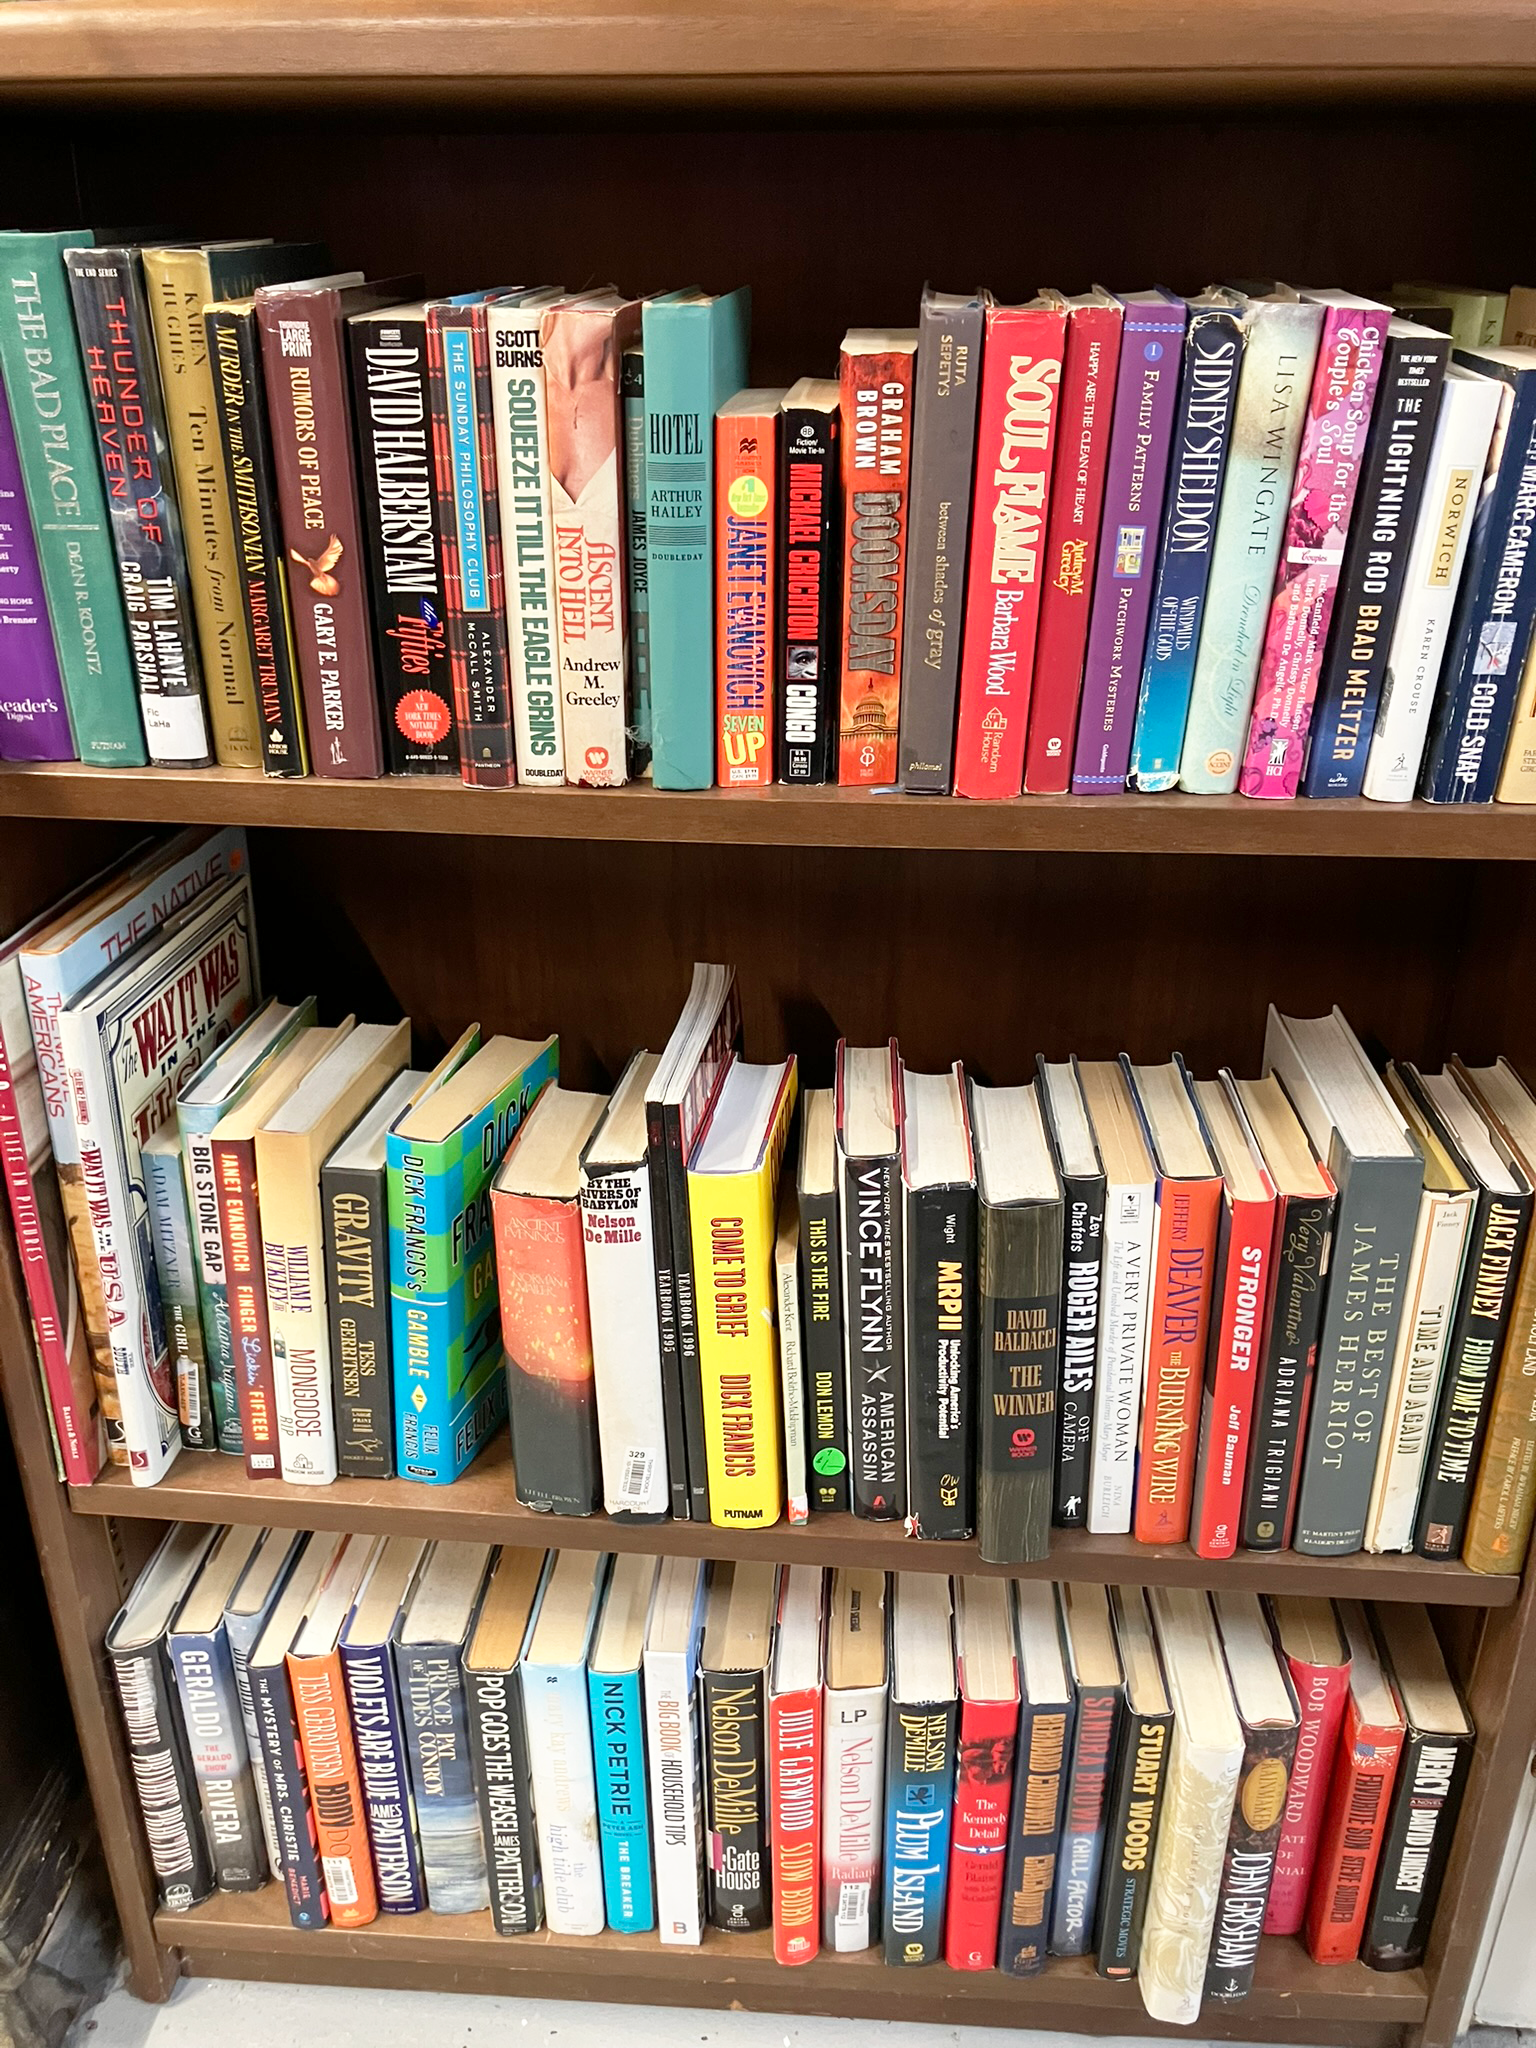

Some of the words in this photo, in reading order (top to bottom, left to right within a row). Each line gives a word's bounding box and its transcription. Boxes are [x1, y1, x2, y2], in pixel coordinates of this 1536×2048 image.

[12, 271, 48, 341] THE
[184, 293, 207, 366] KAREN
[280, 329, 311, 342] LARGE
[496, 330, 540, 347] SCOTT
[496, 350, 543, 368] BURNS
[24, 347, 63, 419] BAD
[366, 347, 424, 425] DAVID
[938, 335, 953, 397] SEPETYS
[955, 345, 968, 386] RUTA
[1270, 355, 1297, 414] LISA
[87, 346, 128, 497] HEAVEN
[106, 297, 152, 480] THUNDER
[138, 498, 163, 543] OF
[290, 367, 316, 442] RUMORS
[880, 382, 904, 475] GRAHAM
[650, 413, 703, 455] HOTEL
[855, 390, 878, 469] BROWN
[41, 424, 81, 516] PLACE
[298, 447, 319, 470] OF
[301, 474, 325, 530] PEACE
[373, 430, 438, 594] HALBERSTAM
[651, 490, 702, 502] ARTHUR
[651, 506, 702, 518] HAILEY
[789, 463, 823, 544] MICHAEL
[1247, 427, 1286, 555] WINGATE
[936, 501, 952, 550] between
[1435, 477, 1468, 580] NORWICH
[727, 516, 767, 585] JANET
[147, 576, 176, 610] TIM
[788, 550, 821, 640] CRICHTON
[849, 492, 901, 675] DOOMSDAY
[933, 555, 950, 604] shades
[928, 608, 945, 626] of
[1113, 588, 1133, 660] PATCHWORK
[1351, 605, 1383, 661] BRAD
[1420, 619, 1436, 660] KAREN
[153, 620, 187, 687] LAHAYE
[467, 623, 479, 675] McCALL
[563, 657, 621, 671] Andrew
[726, 592, 766, 709] EVANOVICH
[924, 629, 944, 670] gray
[472, 681, 483, 722] SMITH
[566, 692, 621, 708] Greeley
[785, 684, 817, 743] CONGO
[1104, 665, 1123, 732] MYSTERIES
[1408, 666, 1425, 714] CROUSE
[1465, 683, 1498, 731] COLD
[1332, 669, 1370, 760] MELTZER
[525, 768, 564, 777] DOUBLEDAY
[722, 732, 766, 766] UP
[990, 732, 1004, 773] Random
[1266, 766, 1283, 776] HCI
[1455, 735, 1486, 783] SNAP
[193, 1147, 211, 1174] BIG
[221, 1154, 241, 1193] JANET
[587, 1179, 603, 1189] BY
[605, 1178, 631, 1188] THE
[197, 1181, 218, 1234] STONE
[582, 1199, 638, 1209] BABYLON
[587, 1214, 636, 1228] Nelson
[858, 1168, 882, 1258] VINCE
[883, 1189, 891, 1216] YORK
[227, 1199, 250, 1272] EVANOVICH
[333, 1193, 374, 1308] GRAVITY
[711, 1217, 746, 1265] COME
[810, 1218, 828, 1248] THIS
[883, 1218, 891, 1247] TIMES
[204, 1241, 223, 1273] GAP
[714, 1268, 747, 1288] TO
[811, 1251, 828, 1264] IS
[812, 1267, 829, 1290] THE
[884, 1249, 892, 1310] BESTSELLING
[1343, 1223, 1376, 1322] JAMES
[659, 1269, 674, 1324] YEARBOOK
[678, 1272, 695, 1328] YEARBOOK
[783, 1272, 796, 1312] Alexander
[813, 1294, 830, 1321] FIRE
[1067, 1260, 1100, 1332] ROGER
[1371, 1253, 1400, 1316] THE
[715, 1292, 749, 1337] GRIEF
[785, 1312, 796, 1332] Kent
[860, 1268, 884, 1352] FLYNN
[885, 1313, 893, 1351] AUTHOR
[1007, 1308, 1047, 1330] DAVID
[1230, 1246, 1262, 1372] STRONGER
[339, 1318, 360, 1398] GERRITSEN
[359, 1341, 376, 1376] TESS
[407, 1309, 430, 1379] GAMBLE
[663, 1328, 676, 1353] 1995
[681, 1332, 695, 1357] 1996
[950, 1339, 961, 1385] Unlocking
[994, 1327, 1057, 1352] BALDACCI
[815, 1371, 832, 1396] DON
[937, 1339, 949, 1396] Productivity
[1009, 1365, 1042, 1388] THE
[1063, 1336, 1096, 1393] AILES
[1359, 1329, 1388, 1399] BEST
[290, 1349, 321, 1437] MONGOOSE
[720, 1374, 752, 1409] DICK
[950, 1386, 962, 1430] America's
[1271, 1357, 1298, 1428] ADRIANA
[1322, 1336, 1360, 1470] HERRIOT
[817, 1399, 834, 1439] LEMON
[862, 1394, 878, 1481] ASSASSIN
[879, 1391, 896, 1483] AMERICAN
[938, 1397, 950, 1439] Potential
[1352, 1411, 1374, 1443] OF
[629, 1450, 646, 1459] 329
[722, 1413, 756, 1477] FRANCIS
[1260, 1439, 1287, 1509] TRIGIANI
[412, 1659, 427, 1672] OF
[448, 1666, 460, 1690] THE
[409, 1677, 433, 1727] TIDES
[427, 1659, 454, 1727] PRINCE
[476, 1675, 507, 1711] POP
[602, 1683, 627, 1735] NICK
[841, 1709, 867, 1724] LP
[1308, 1677, 1329, 1713] BOB
[181, 1650, 223, 1738] GERALDO
[205, 1779, 242, 1844] RIVERA
[480, 1712, 511, 1752] GOES
[778, 1708, 814, 1751] JULIE
[926, 1713, 947, 1773] NELSON
[485, 1753, 515, 1781] THE
[607, 1743, 632, 1816] PETRIE
[1133, 1724, 1165, 1795] STUART
[1286, 1718, 1321, 1824] WOODWARD
[1413, 1745, 1458, 1797] MERCY
[370, 1804, 402, 1818] JAMES
[487, 1783, 518, 1838] WEASEL
[780, 1756, 814, 1832] GARWOOD
[976, 1799, 997, 1810] The
[493, 1836, 520, 1847] JAMES
[969, 1827, 999, 1839] Detail
[1122, 1800, 1155, 1872] WOODS
[371, 1817, 413, 1902] PATTERSON
[780, 1842, 813, 1882] SLOW
[288, 1867, 301, 1907] BENEDICT
[300, 1875, 310, 1899] MARIE
[494, 1847, 527, 1924] PATTERSON
[781, 1886, 813, 1927] BURN
